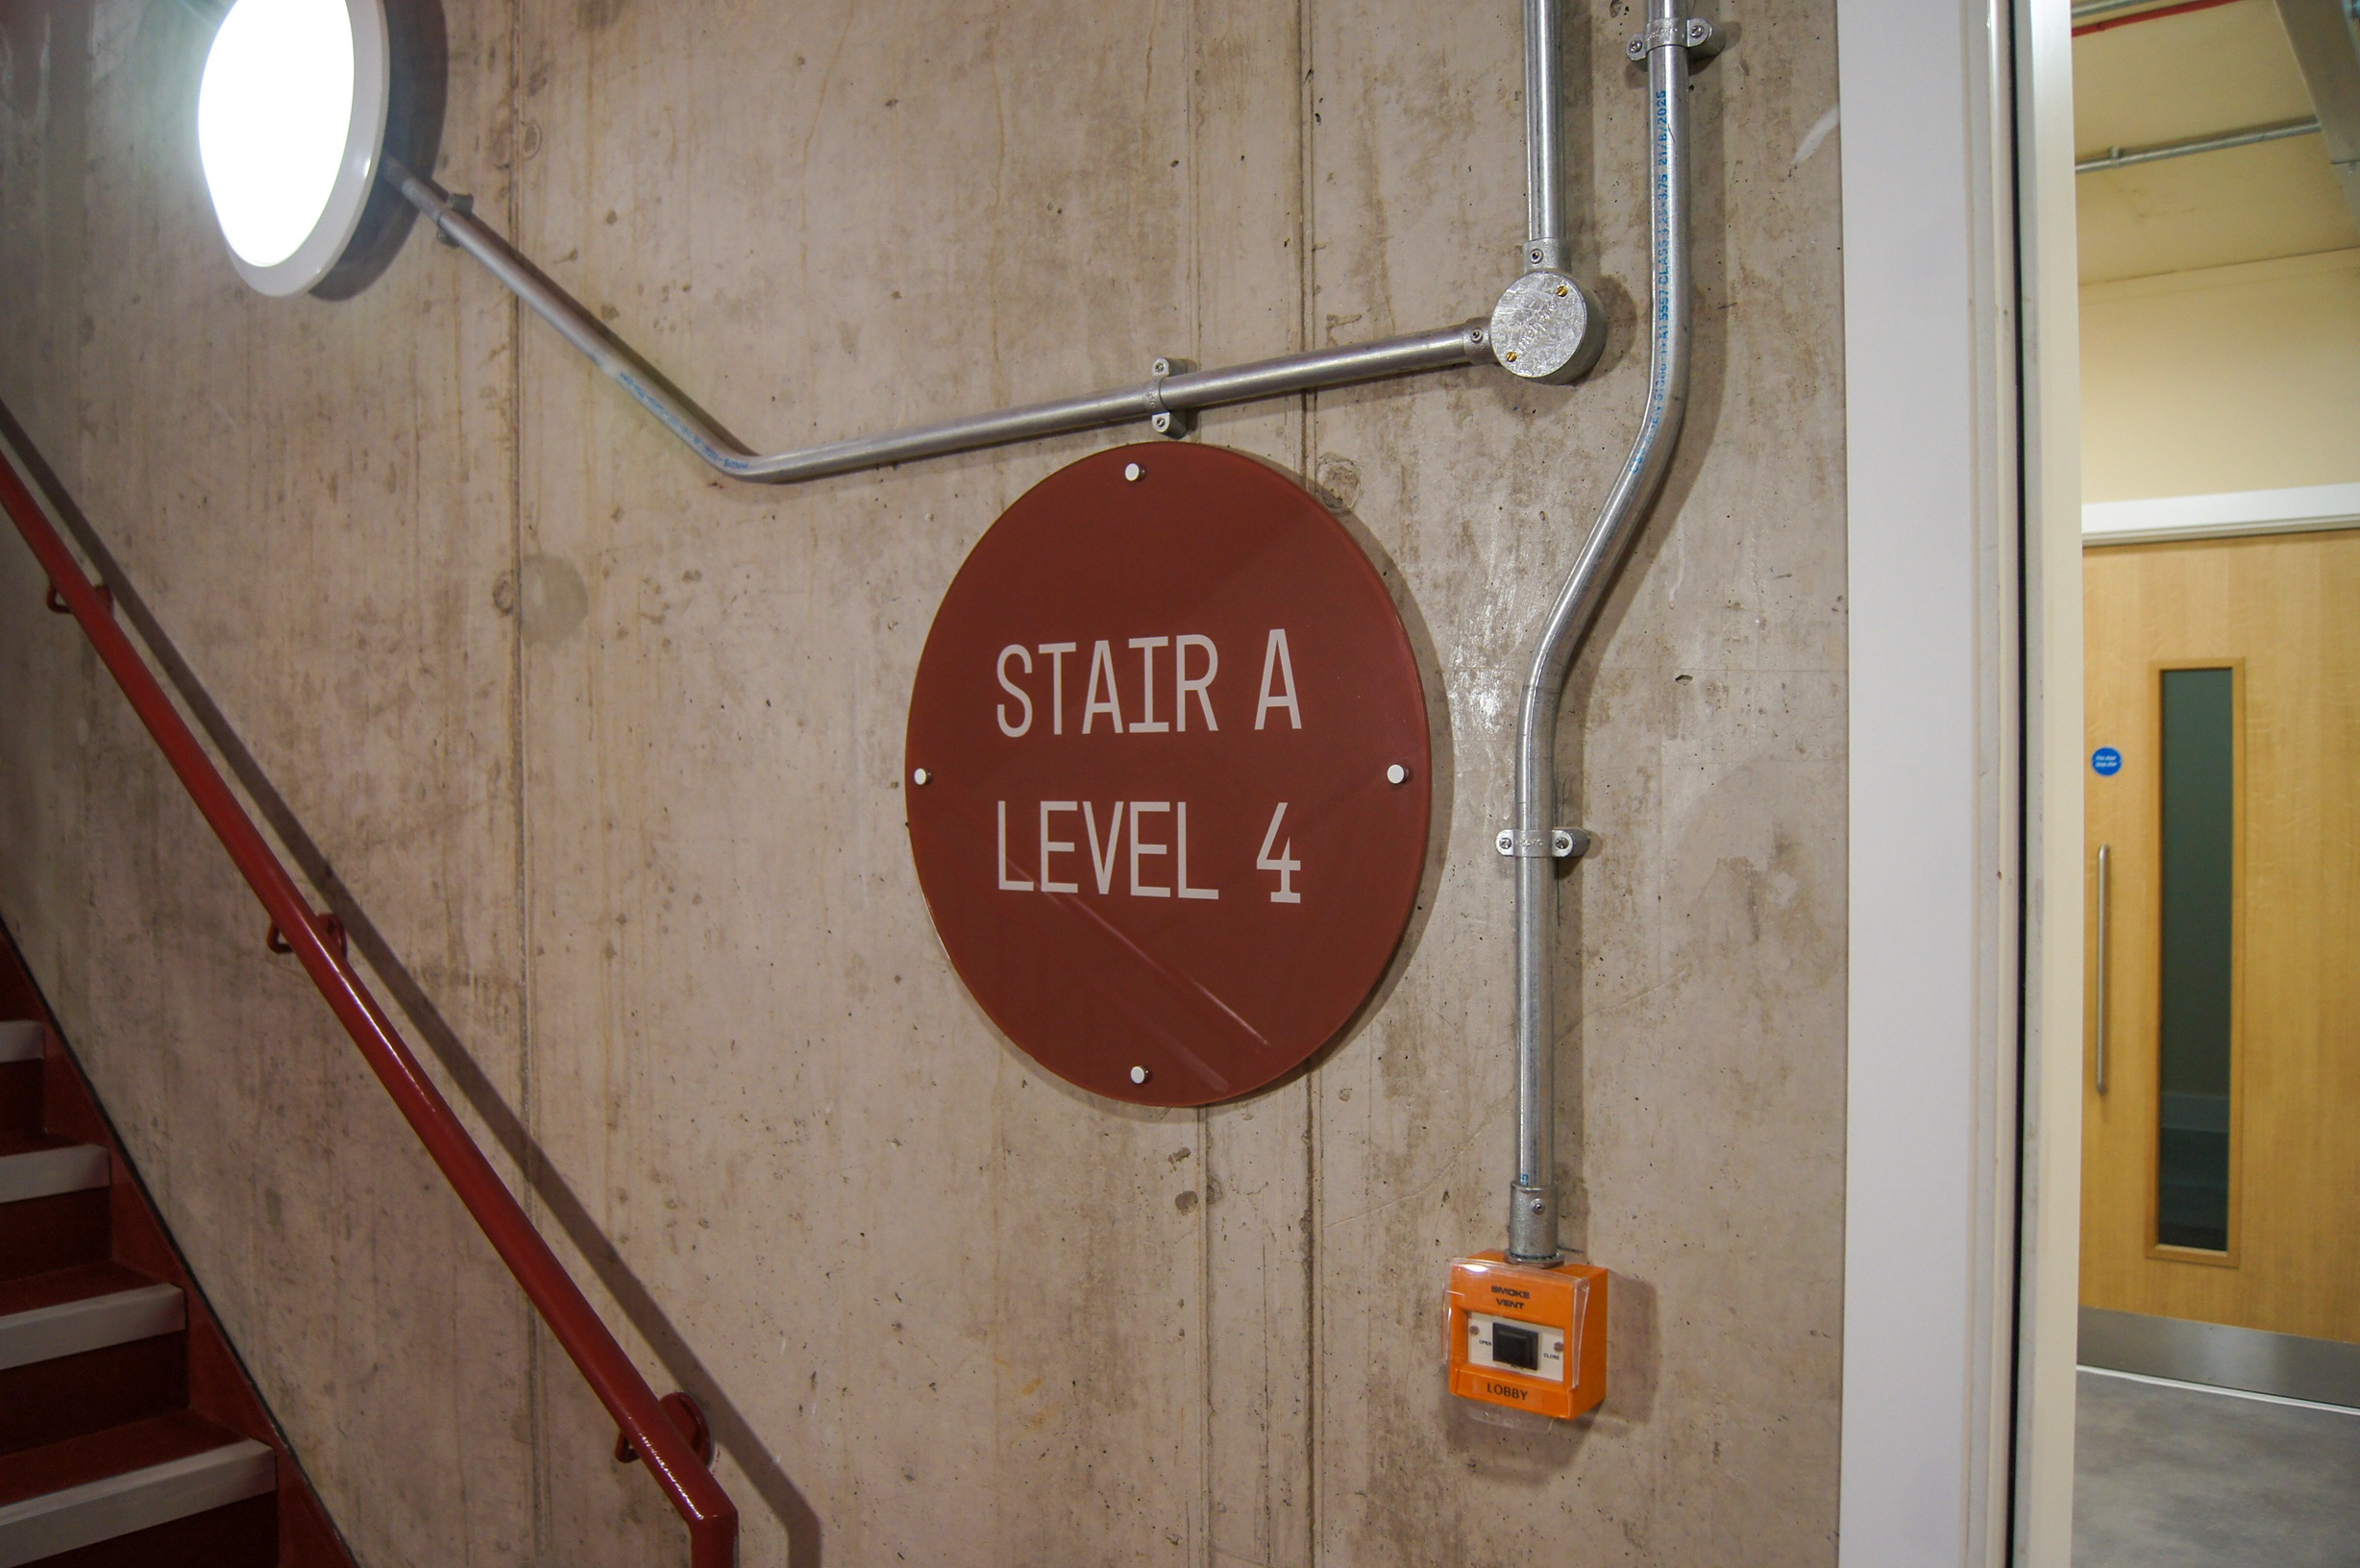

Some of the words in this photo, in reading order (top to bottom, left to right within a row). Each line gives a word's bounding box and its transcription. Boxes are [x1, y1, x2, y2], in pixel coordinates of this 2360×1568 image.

[1658, 240, 1668, 285] CLASS
[996, 634, 1219, 737] STAIR
[1254, 628, 1302, 730] A
[997, 800, 1219, 899] LEVEL
[1256, 802, 1301, 903] 4
[1491, 1286, 1530, 1298] SMOKE
[1495, 1298, 1525, 1310] VENT
[1487, 1383, 1528, 1400] LOBBY
